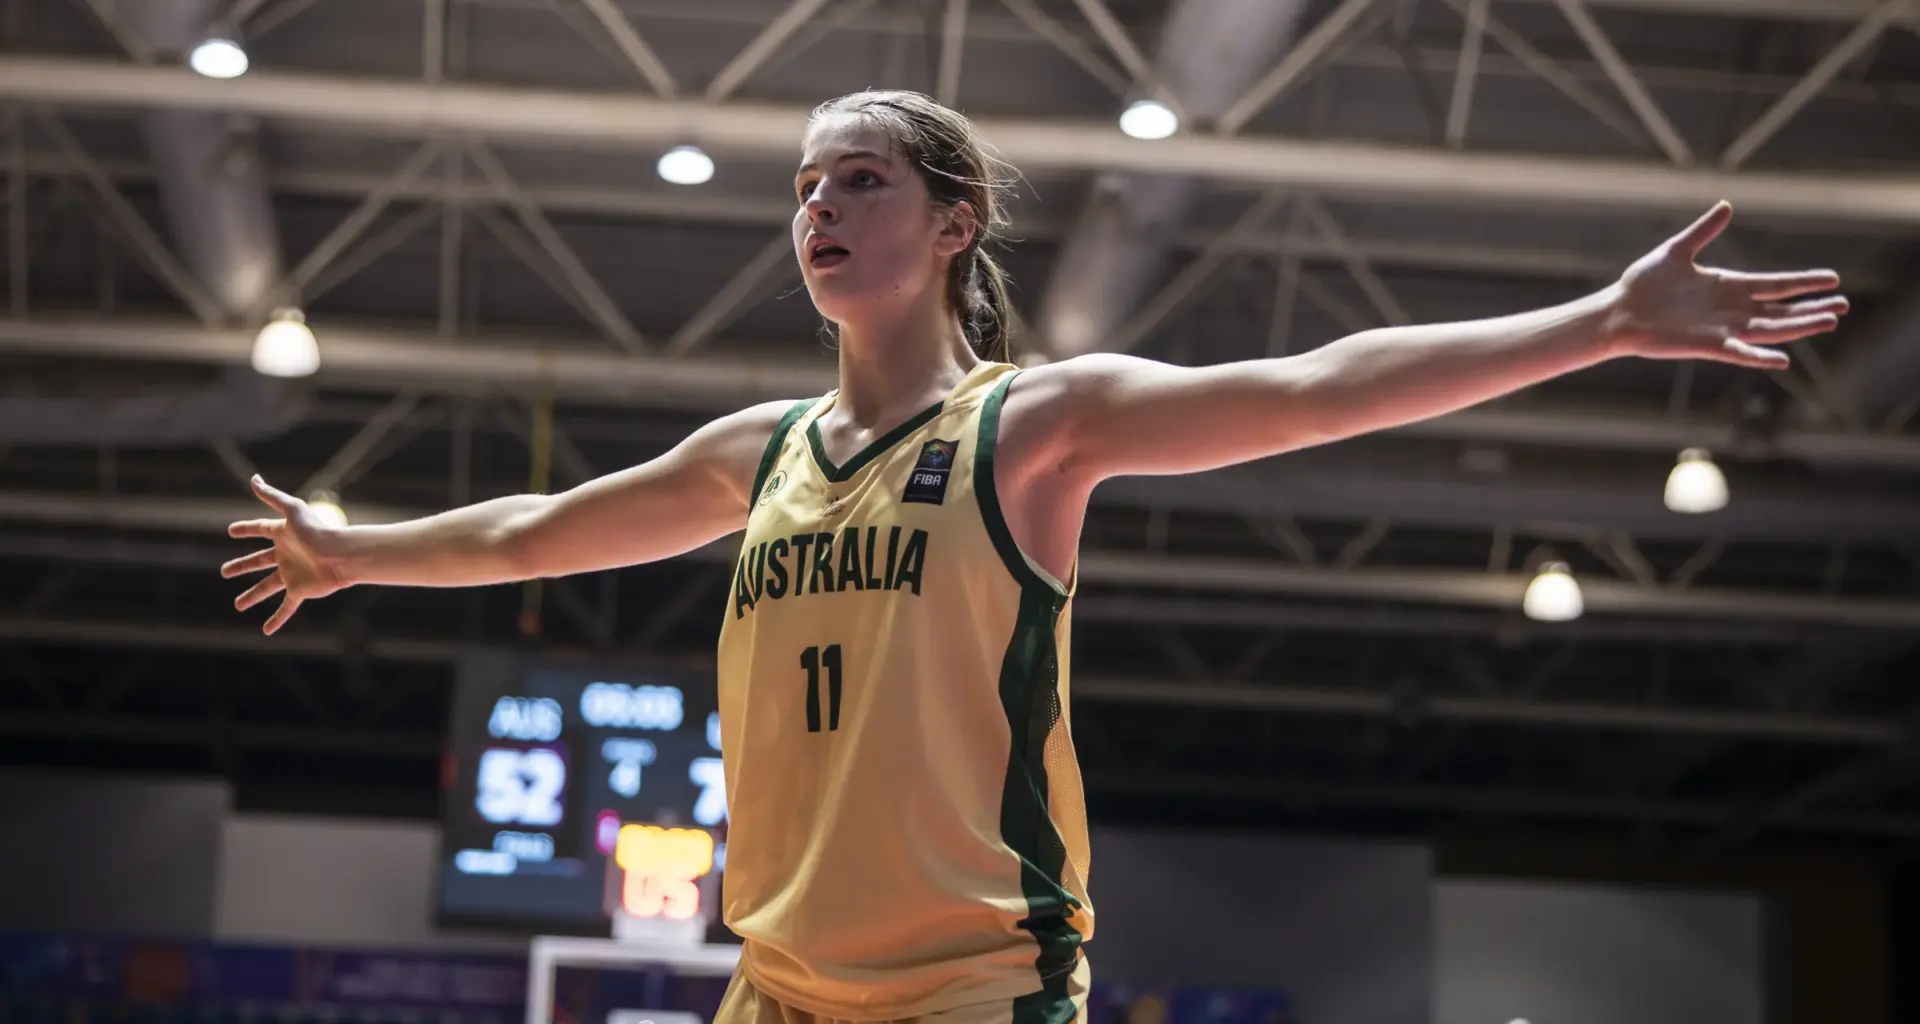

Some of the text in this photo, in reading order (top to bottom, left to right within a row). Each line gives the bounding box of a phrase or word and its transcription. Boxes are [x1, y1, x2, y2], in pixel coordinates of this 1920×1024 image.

[913, 473, 942, 486] FIBA
[735, 526, 928, 620] AUSTRALIA
[488, 696, 563, 742] AUS
[800, 644, 842, 732] 11
[476, 748, 567, 826] 52
